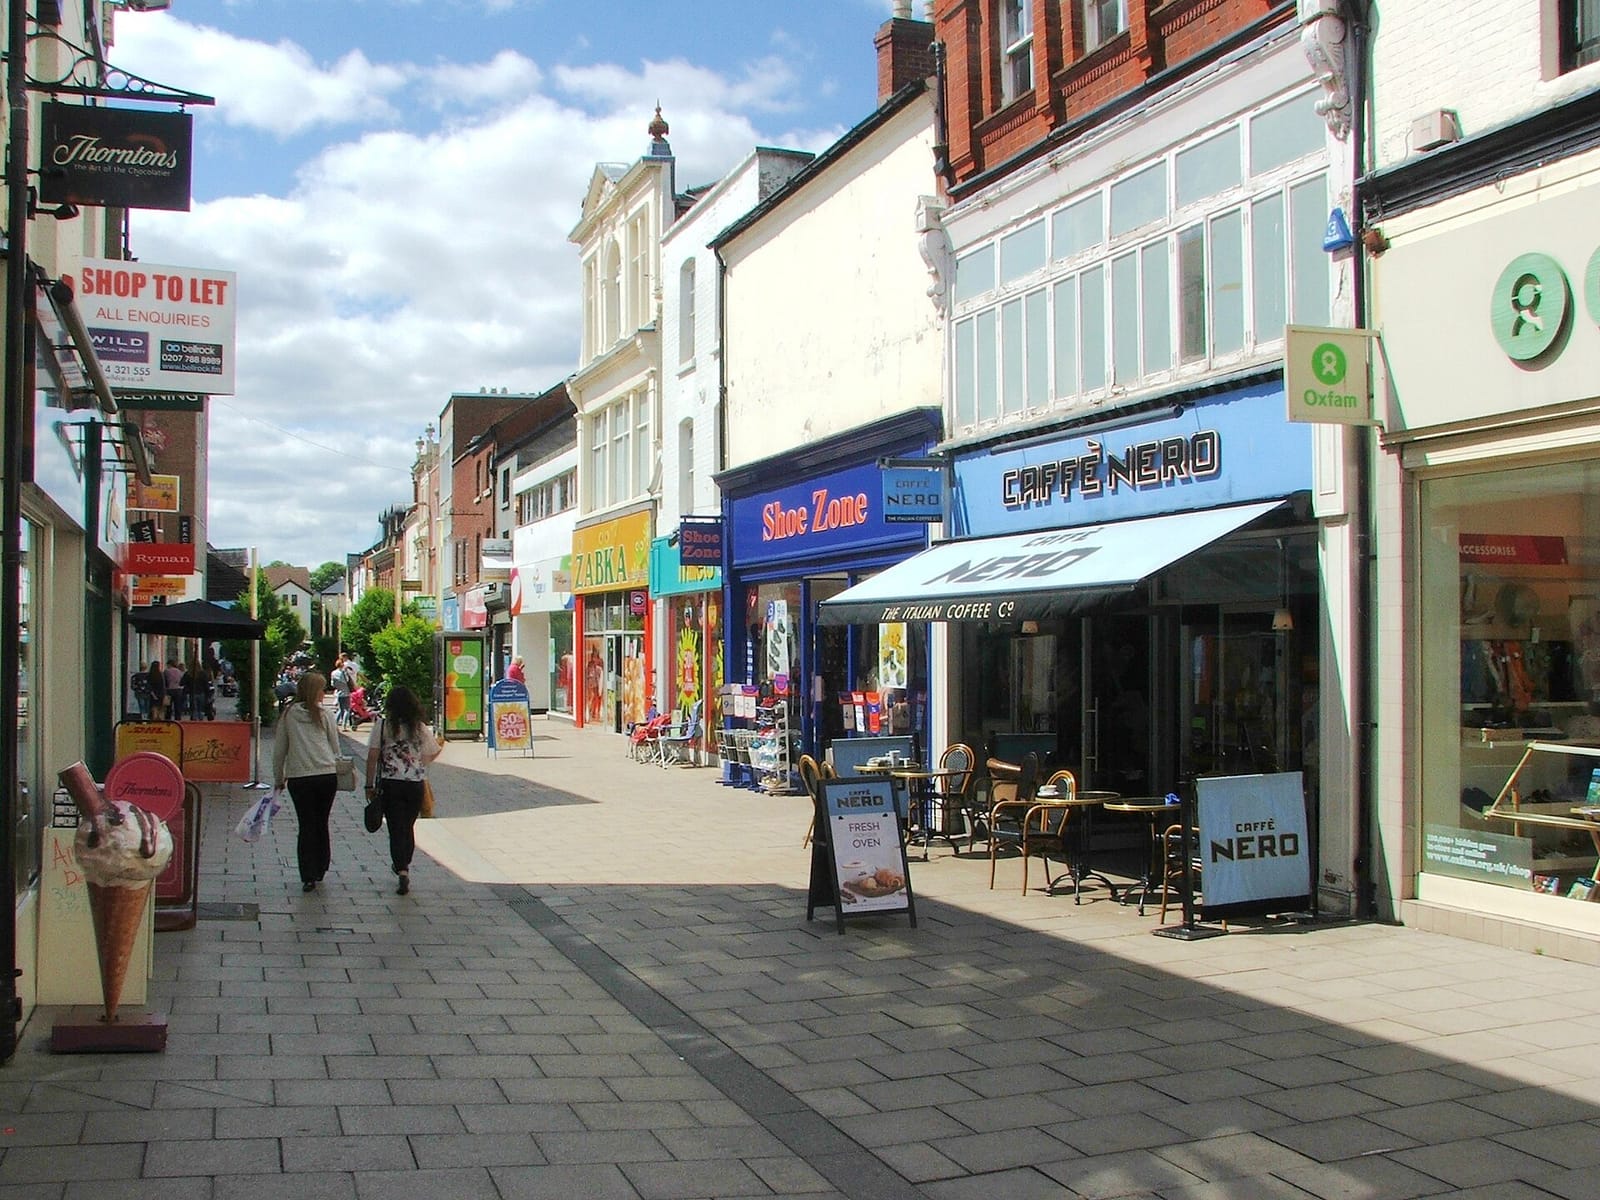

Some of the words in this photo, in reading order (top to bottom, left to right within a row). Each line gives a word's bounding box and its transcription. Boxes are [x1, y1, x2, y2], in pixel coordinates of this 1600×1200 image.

[53, 134, 177, 169] Thorntons
[82, 268, 147, 298] SHOP
[152, 274, 183, 302] TO
[190, 278, 228, 305] LET
[96, 307, 123, 321] ALL
[128, 309, 210, 328] ENQUIRIES
[162, 354, 183, 362] 0207
[114, 365, 131, 375] 321
[133, 367, 151, 376] 555
[1303, 389, 1357, 408] Oxfam
[1106, 429, 1218, 492] NERO
[887, 493, 940, 505] NERO
[762, 500, 807, 542] Shoe
[811, 487, 868, 533] Zone
[682, 529, 720, 544] Shoe
[136, 554, 190, 563] Ryman
[682, 545, 721, 558] Zone
[575, 546, 626, 588] ZABKA
[920, 546, 1103, 585] NERO
[881, 607, 899, 620] THE
[902, 606, 942, 619] ITALIAN
[947, 602, 992, 619] COFFEE
[500, 729, 526, 738] SALE
[116, 783, 172, 797] Thorntons
[837, 796, 884, 808] NERO
[849, 822, 880, 832] FRESH
[1235, 818, 1275, 832] CAFFÈ
[852, 839, 881, 848] OVEN
[1210, 833, 1299, 863] NERO
